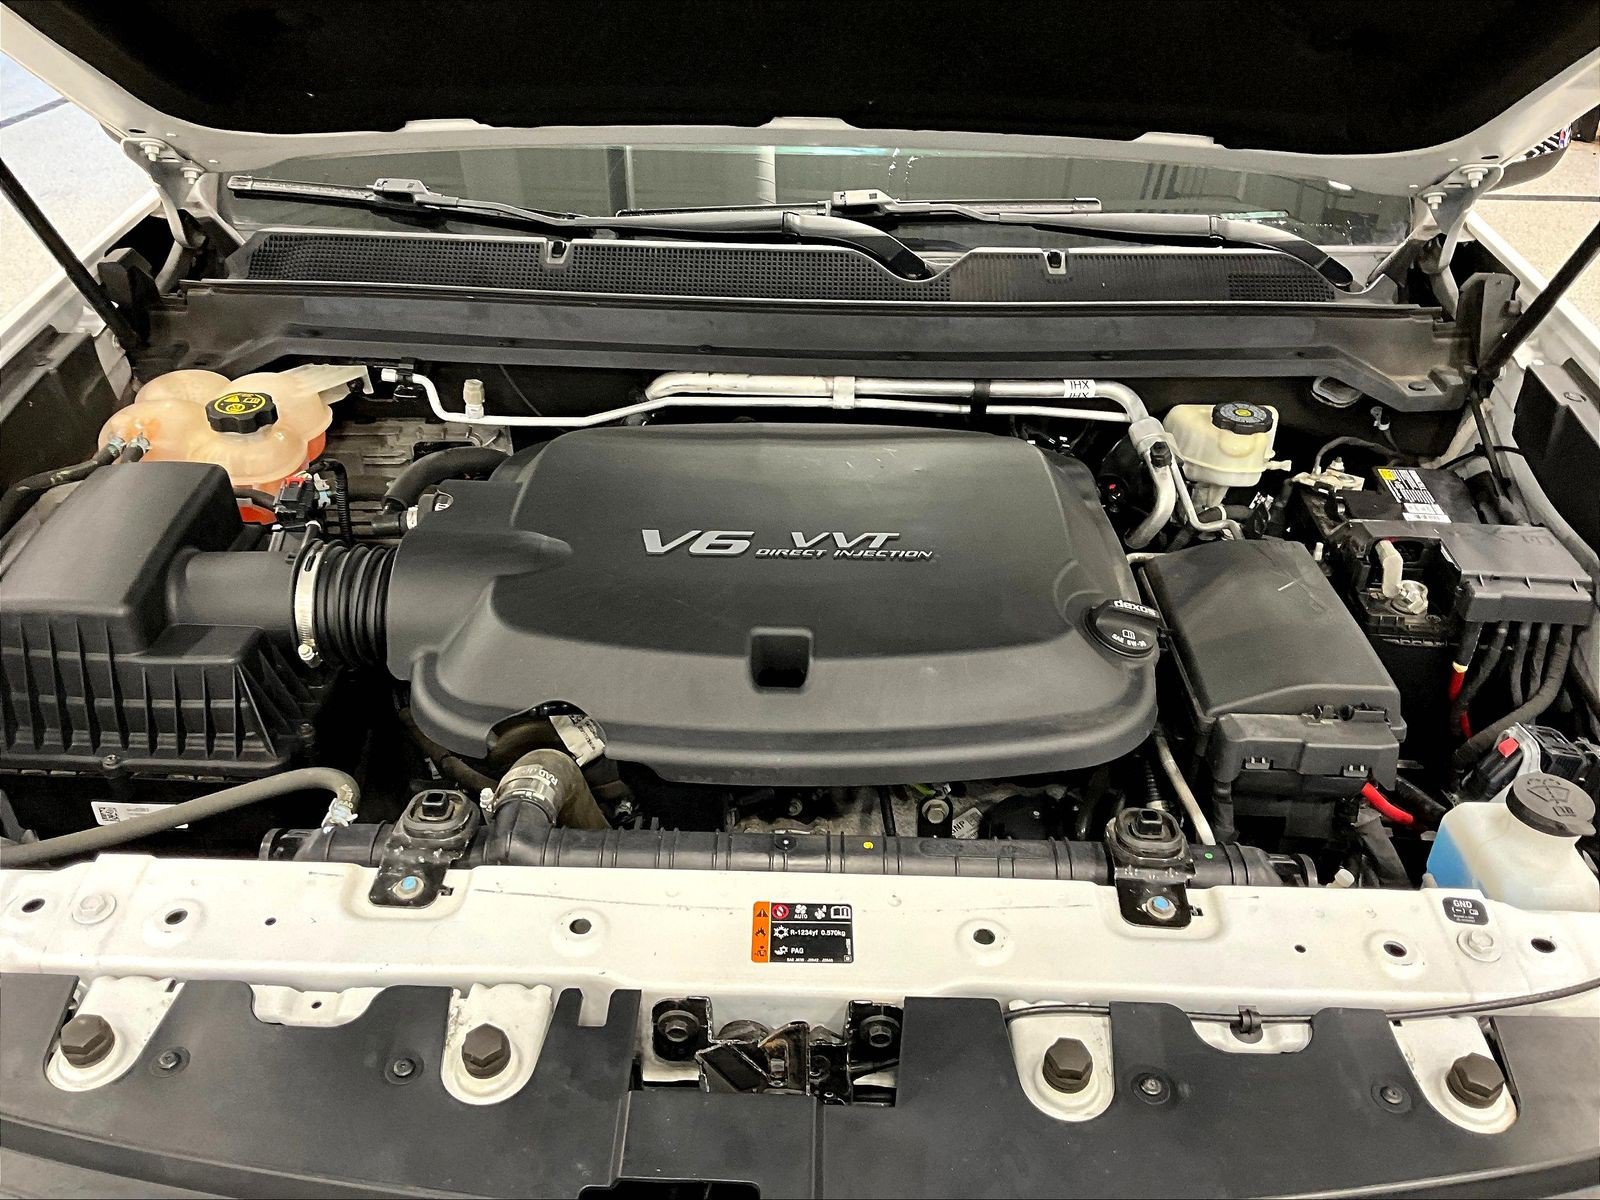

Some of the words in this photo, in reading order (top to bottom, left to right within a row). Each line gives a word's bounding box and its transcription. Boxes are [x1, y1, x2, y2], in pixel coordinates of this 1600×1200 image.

[641, 528, 755, 556] V6
[790, 531, 900, 549] VVT
[755, 548, 828, 558] DIRECT
[833, 549, 934, 560] INJECTION
[538, 768, 558, 786] RAD
[1453, 900, 1472, 908] GND
[789, 928, 819, 936] R-1234yf
